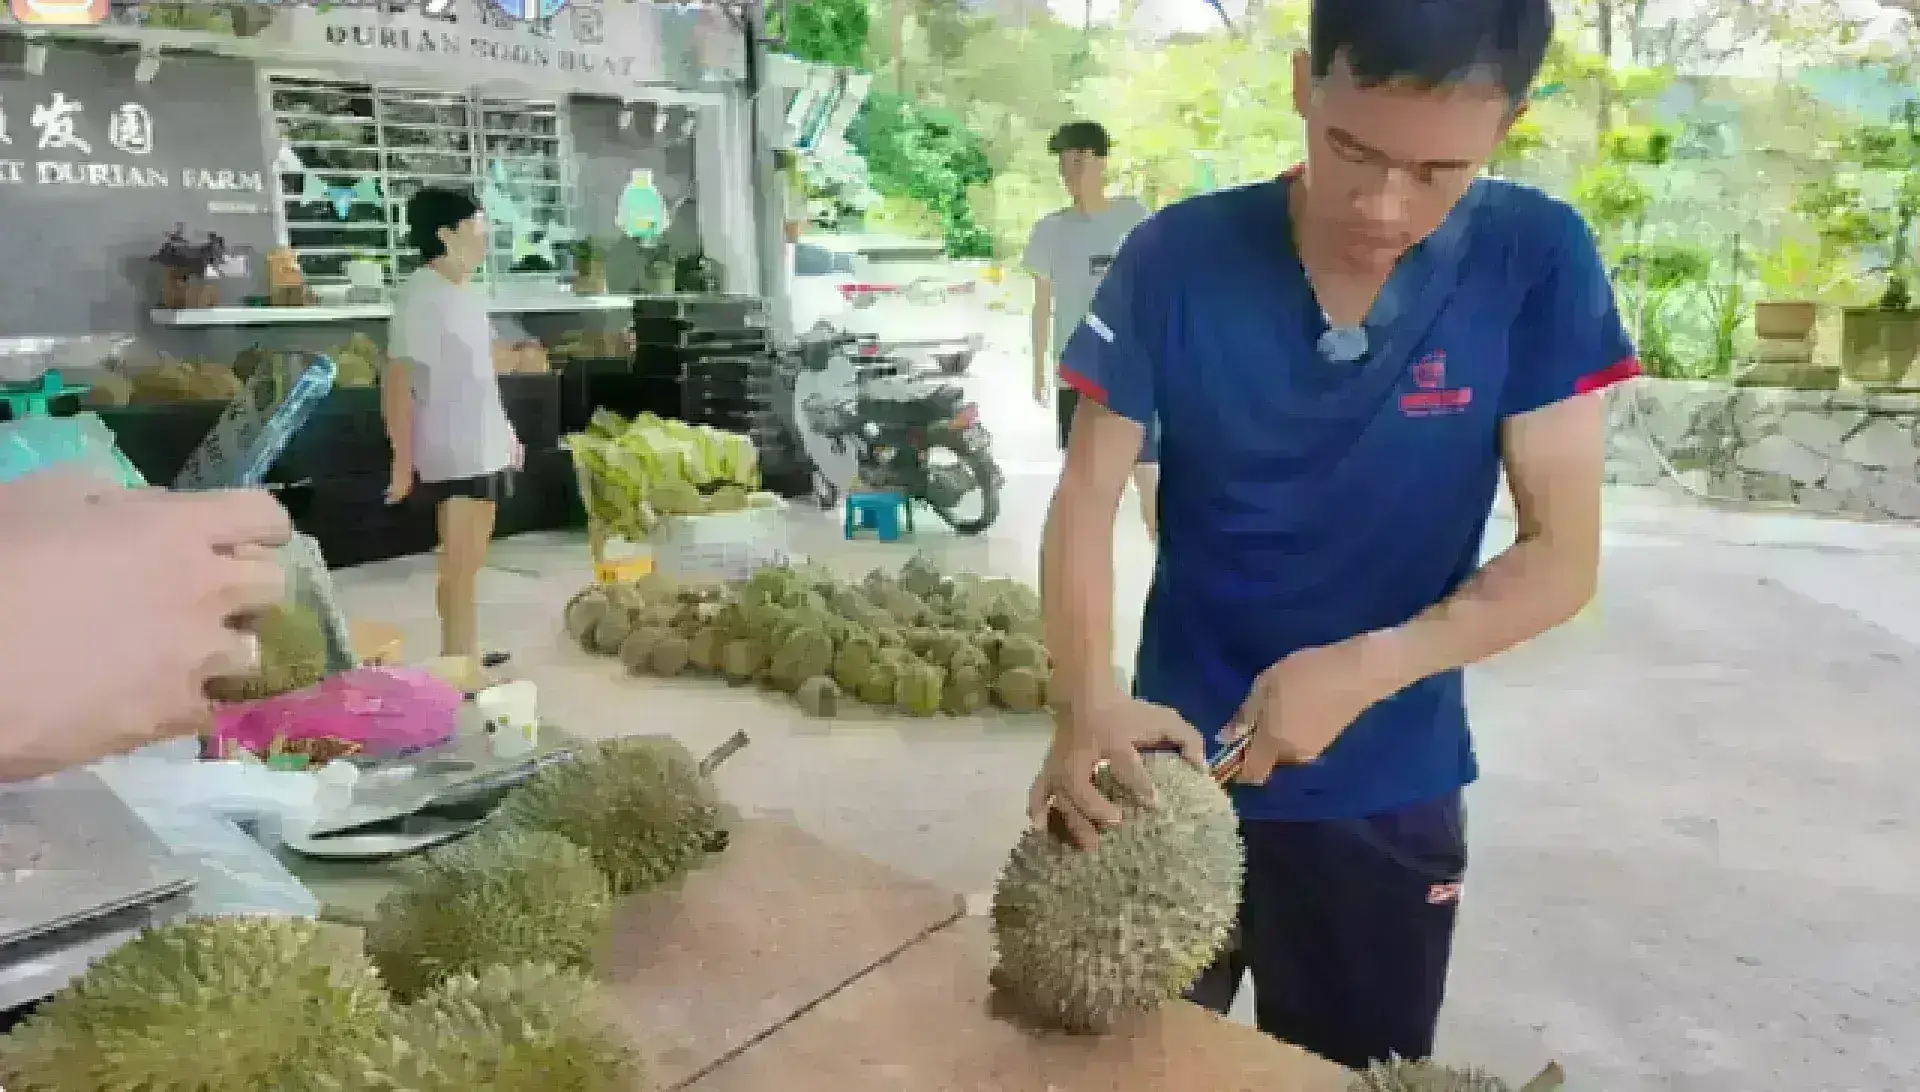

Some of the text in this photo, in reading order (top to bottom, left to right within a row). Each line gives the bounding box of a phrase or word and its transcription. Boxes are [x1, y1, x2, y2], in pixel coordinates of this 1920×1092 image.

[326, 25, 461, 55] DURIAN
[36, 161, 169, 188] DURIAN
[182, 168, 264, 192] FARM
